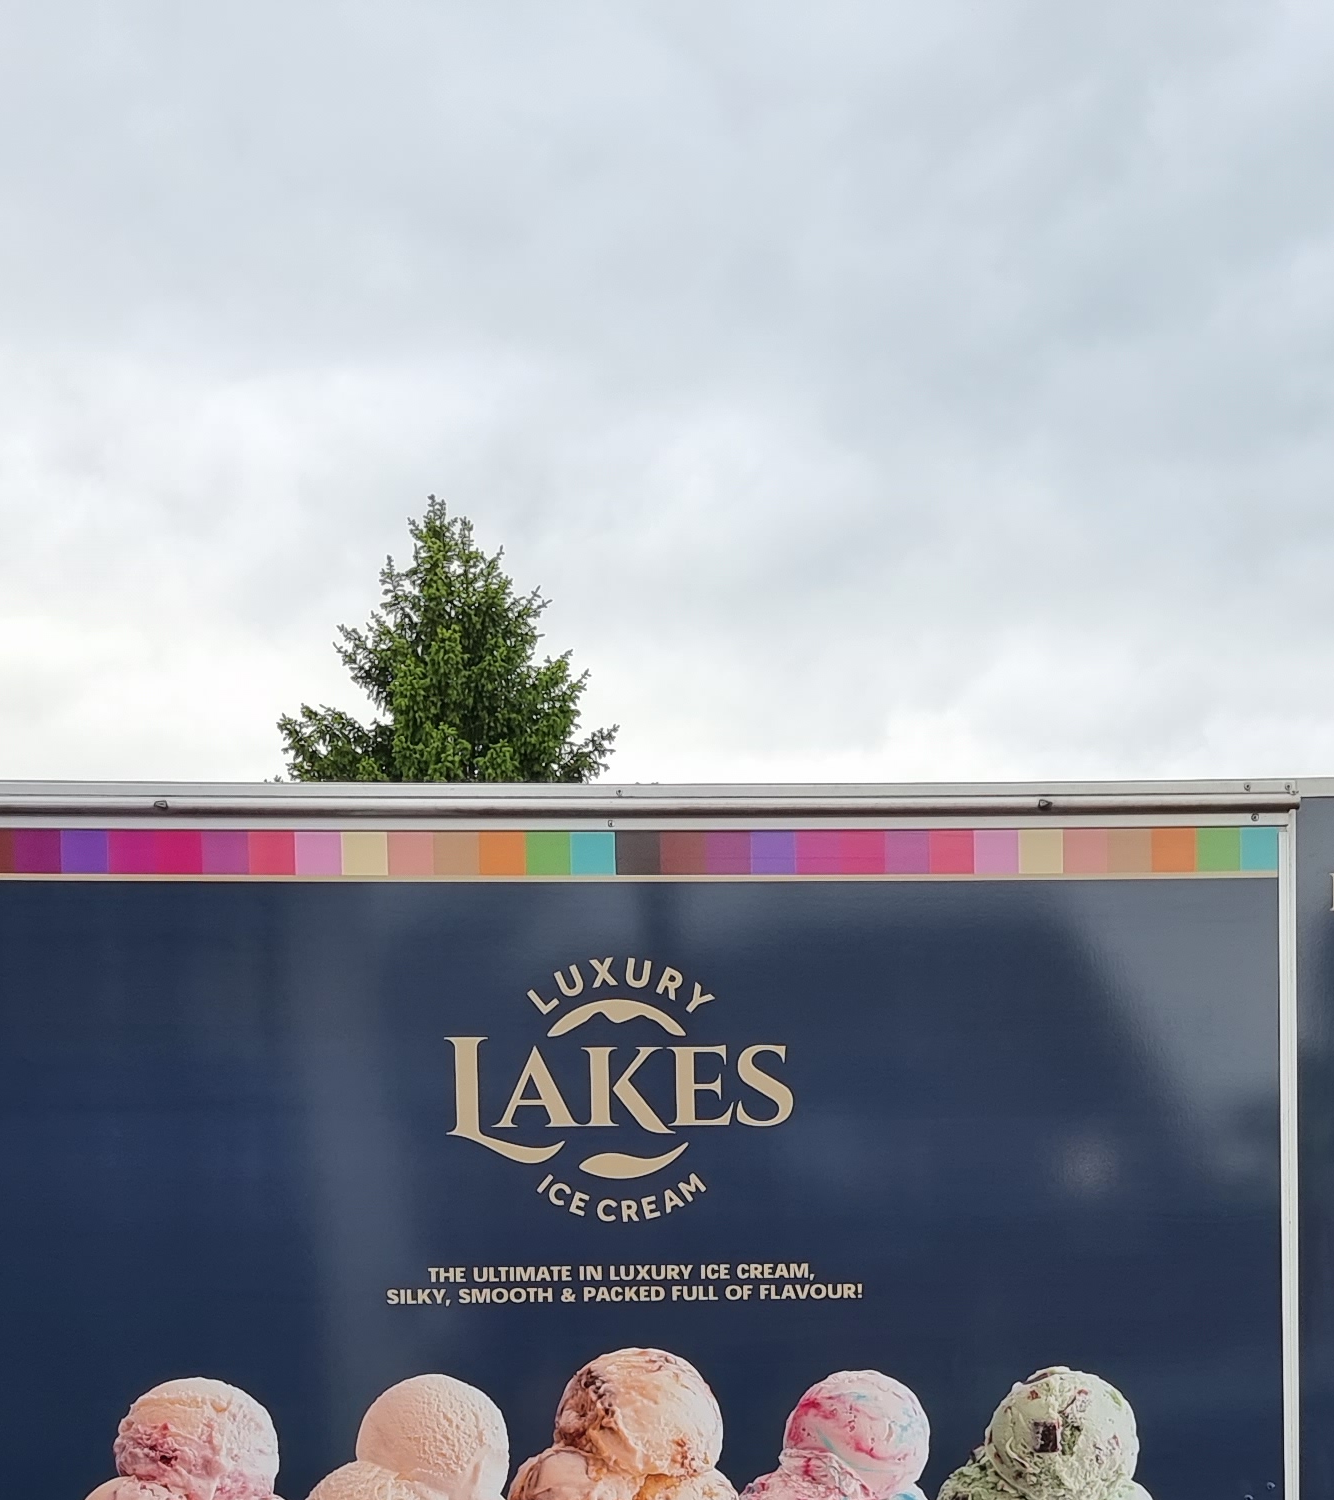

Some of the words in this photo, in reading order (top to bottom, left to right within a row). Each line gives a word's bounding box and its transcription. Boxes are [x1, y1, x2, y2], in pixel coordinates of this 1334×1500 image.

[526, 957, 715, 1015] LUXURY
[444, 1036, 794, 1164] LAKES
[536, 1173, 590, 1217] ICE
[596, 1172, 707, 1223] CREAM
[387, 1288, 451, 1307] SILKY,
[458, 1288, 553, 1304] SMOOTH
[560, 1288, 576, 1303] &
[584, 1286, 665, 1302] PACKED
[672, 1285, 719, 1301] FULL
[724, 1285, 753, 1301] OF
[760, 1283, 863, 1300] FLAVOUR!
[428, 1267, 466, 1283] THE
[473, 1266, 572, 1283] ULTIMATE
[579, 1266, 603, 1281] IN
[610, 1265, 693, 1280] LUXURY
[700, 1264, 730, 1279] ICE
[736, 1263, 815, 1281] CREAM,
